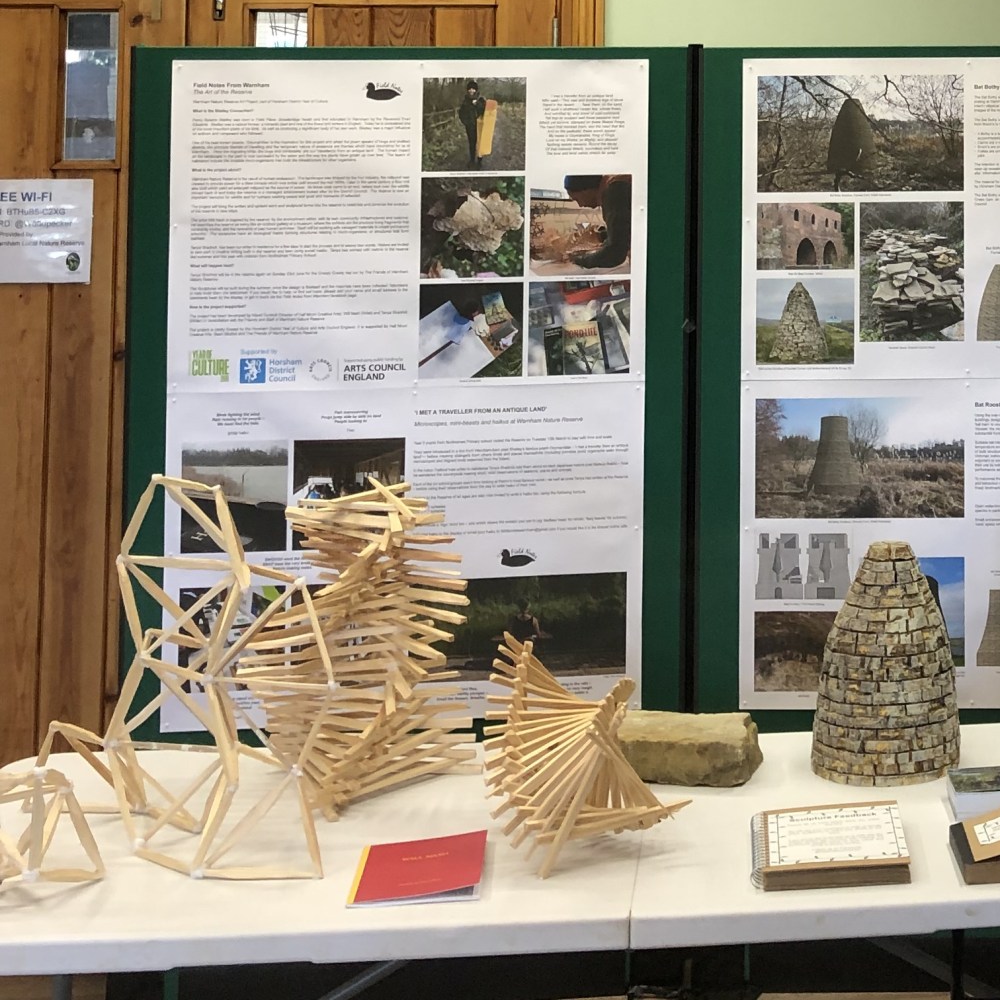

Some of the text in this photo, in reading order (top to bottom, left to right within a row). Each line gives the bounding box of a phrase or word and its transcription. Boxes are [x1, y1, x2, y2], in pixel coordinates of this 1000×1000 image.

[21, 192, 52, 202] WI-FI
[192, 359, 229, 376] CULTURE
[344, 373, 385, 381] ENGLAND
